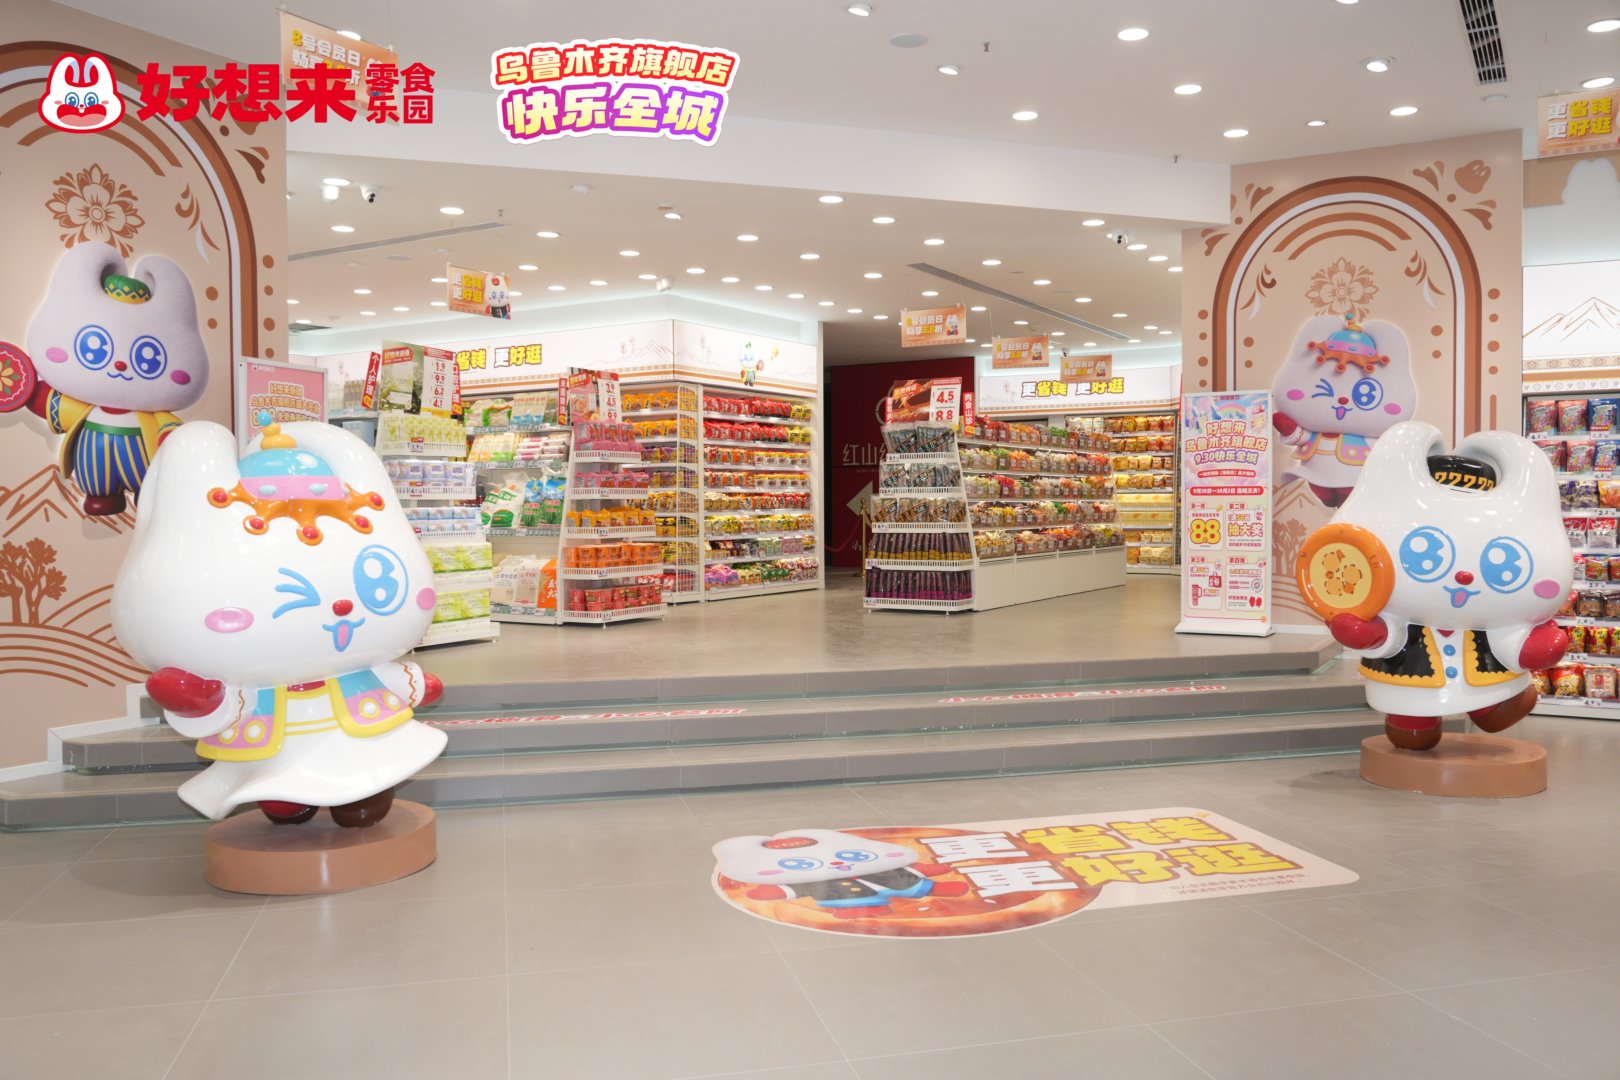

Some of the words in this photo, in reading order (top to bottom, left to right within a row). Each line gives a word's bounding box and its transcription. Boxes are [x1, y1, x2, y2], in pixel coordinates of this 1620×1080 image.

[291, 30, 361, 67] 8号会员日
[1547, 97, 1612, 121] 更省钱
[1547, 117, 1612, 140] 更好逛
[906, 315, 944, 327] 8号会员日
[494, 344, 542, 368] 更好逛
[936, 391, 954, 404] 4.5
[1021, 380, 1068, 397] 更省钱
[1075, 377, 1125, 396] 更好逛
[1206, 420, 1247, 436] 好想来
[1185, 435, 1268, 453] 乌鲁木齐旗舰店
[1228, 522, 1264, 537] 抽大奖
[917, 816, 1237, 864] 更省钱
[955, 842, 1304, 898] 更好逛
